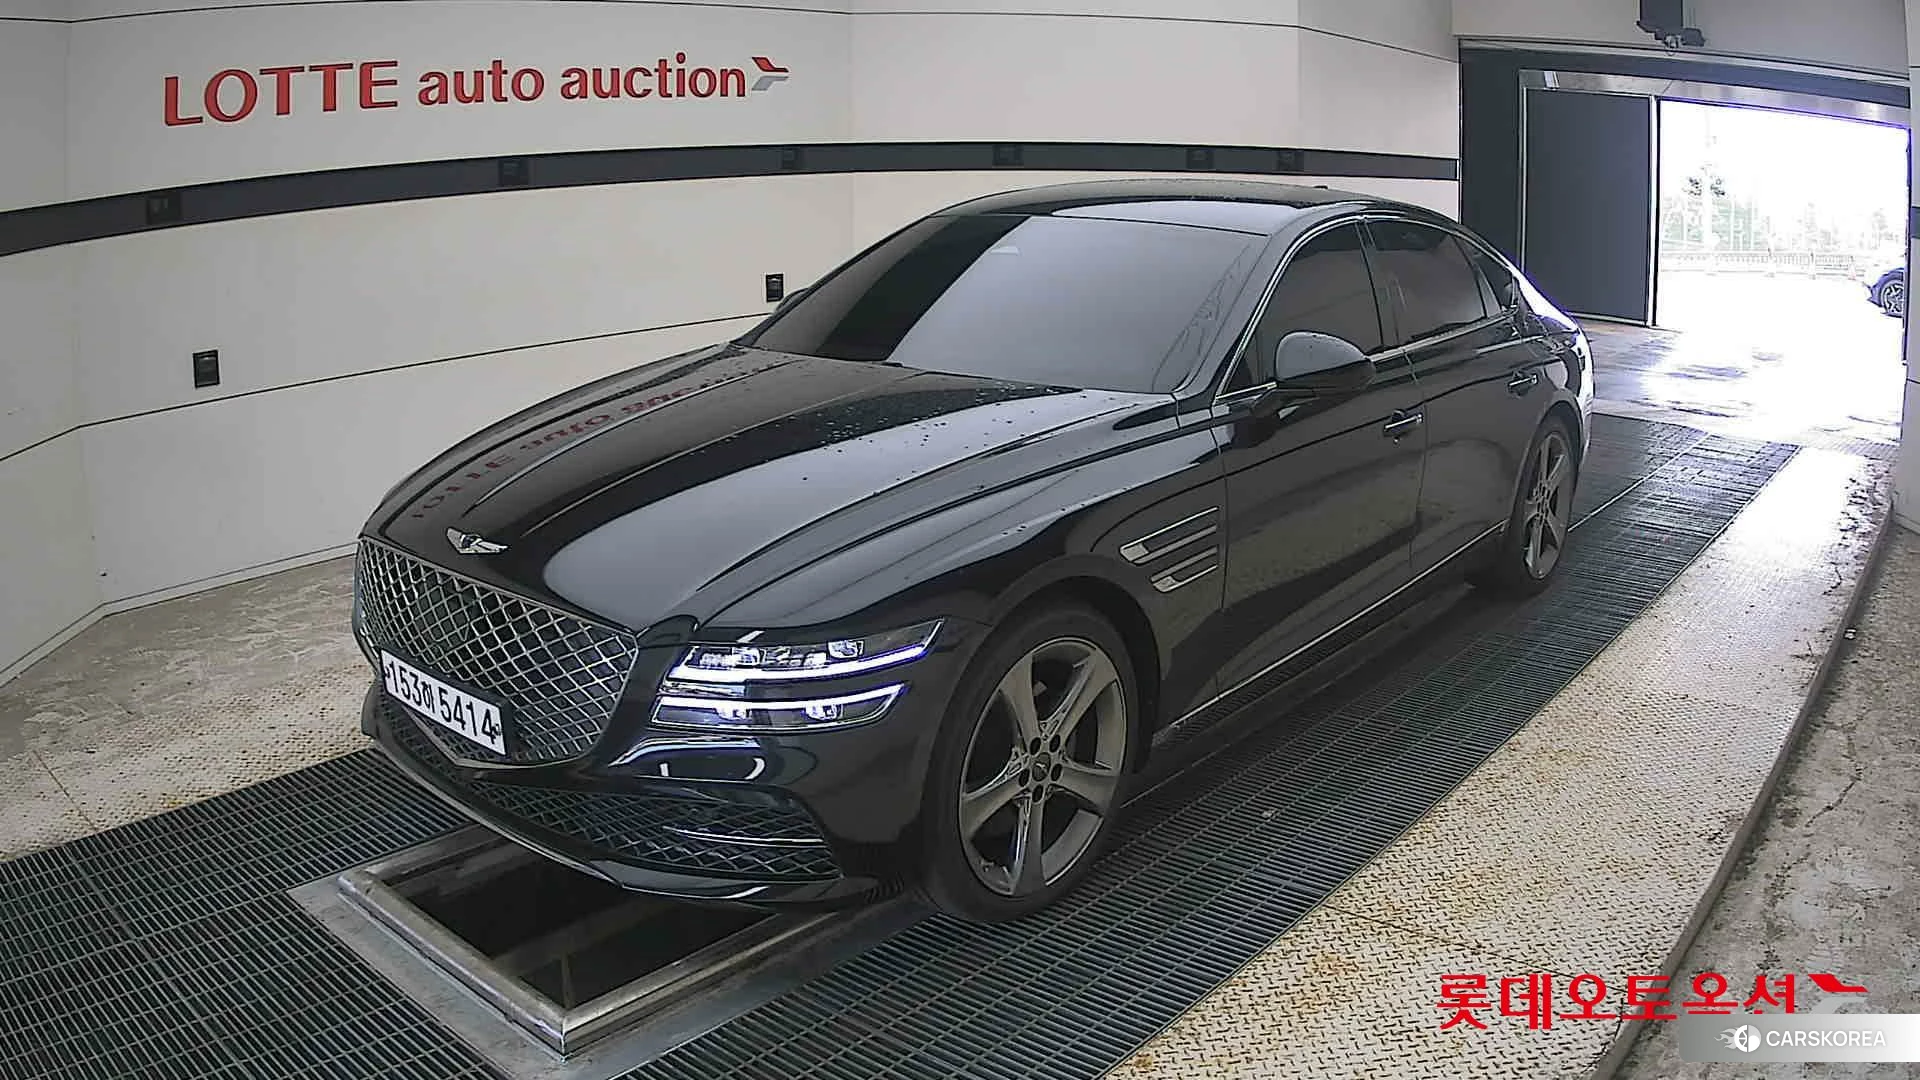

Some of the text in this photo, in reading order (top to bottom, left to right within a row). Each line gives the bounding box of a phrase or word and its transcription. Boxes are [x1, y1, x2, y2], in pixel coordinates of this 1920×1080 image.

[164, 52, 746, 126] LOTTE auto auction
[438, 686, 496, 744] 5414
